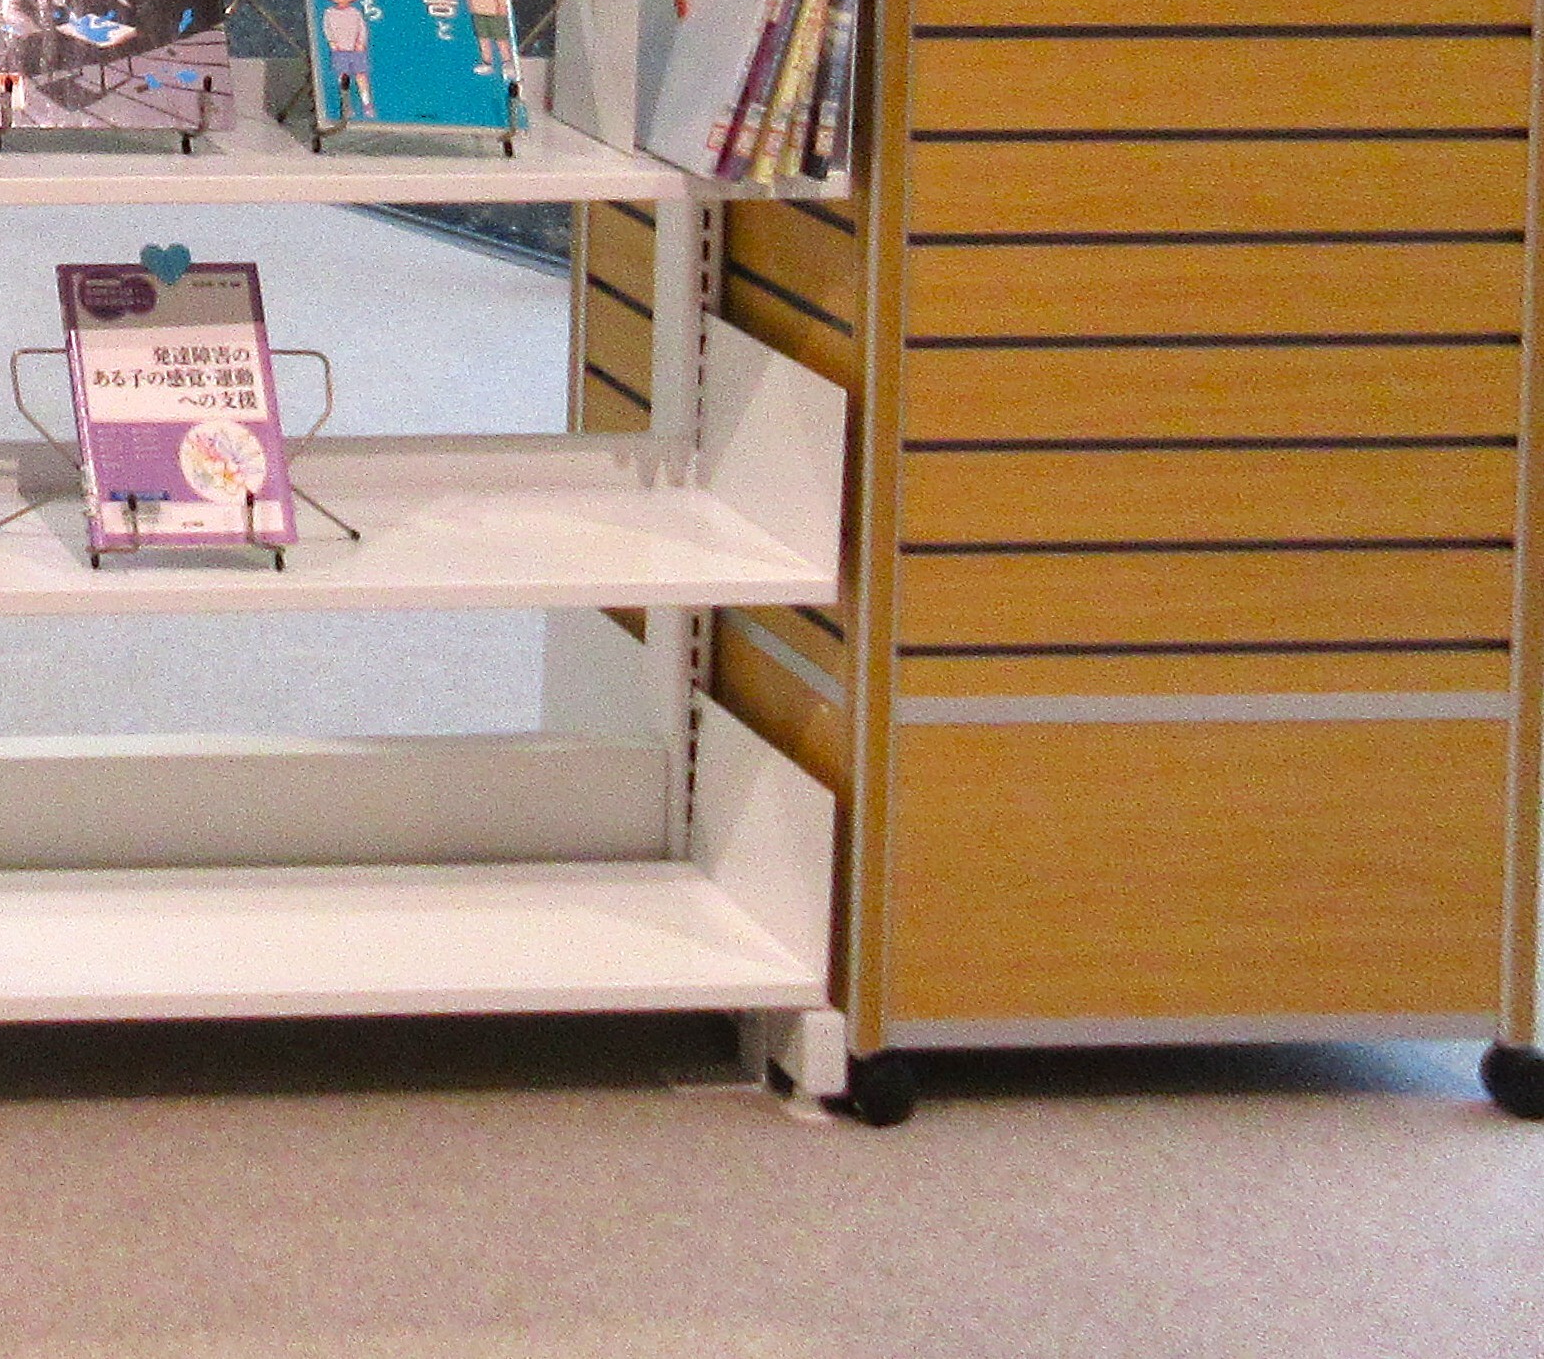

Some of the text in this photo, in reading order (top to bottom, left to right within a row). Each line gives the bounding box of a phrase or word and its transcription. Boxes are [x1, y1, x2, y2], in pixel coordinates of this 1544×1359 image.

[153, 345, 250, 366] 発達障害の
[93, 367, 255, 389] ある子の感覚・運動
[178, 391, 258, 410] への支援
